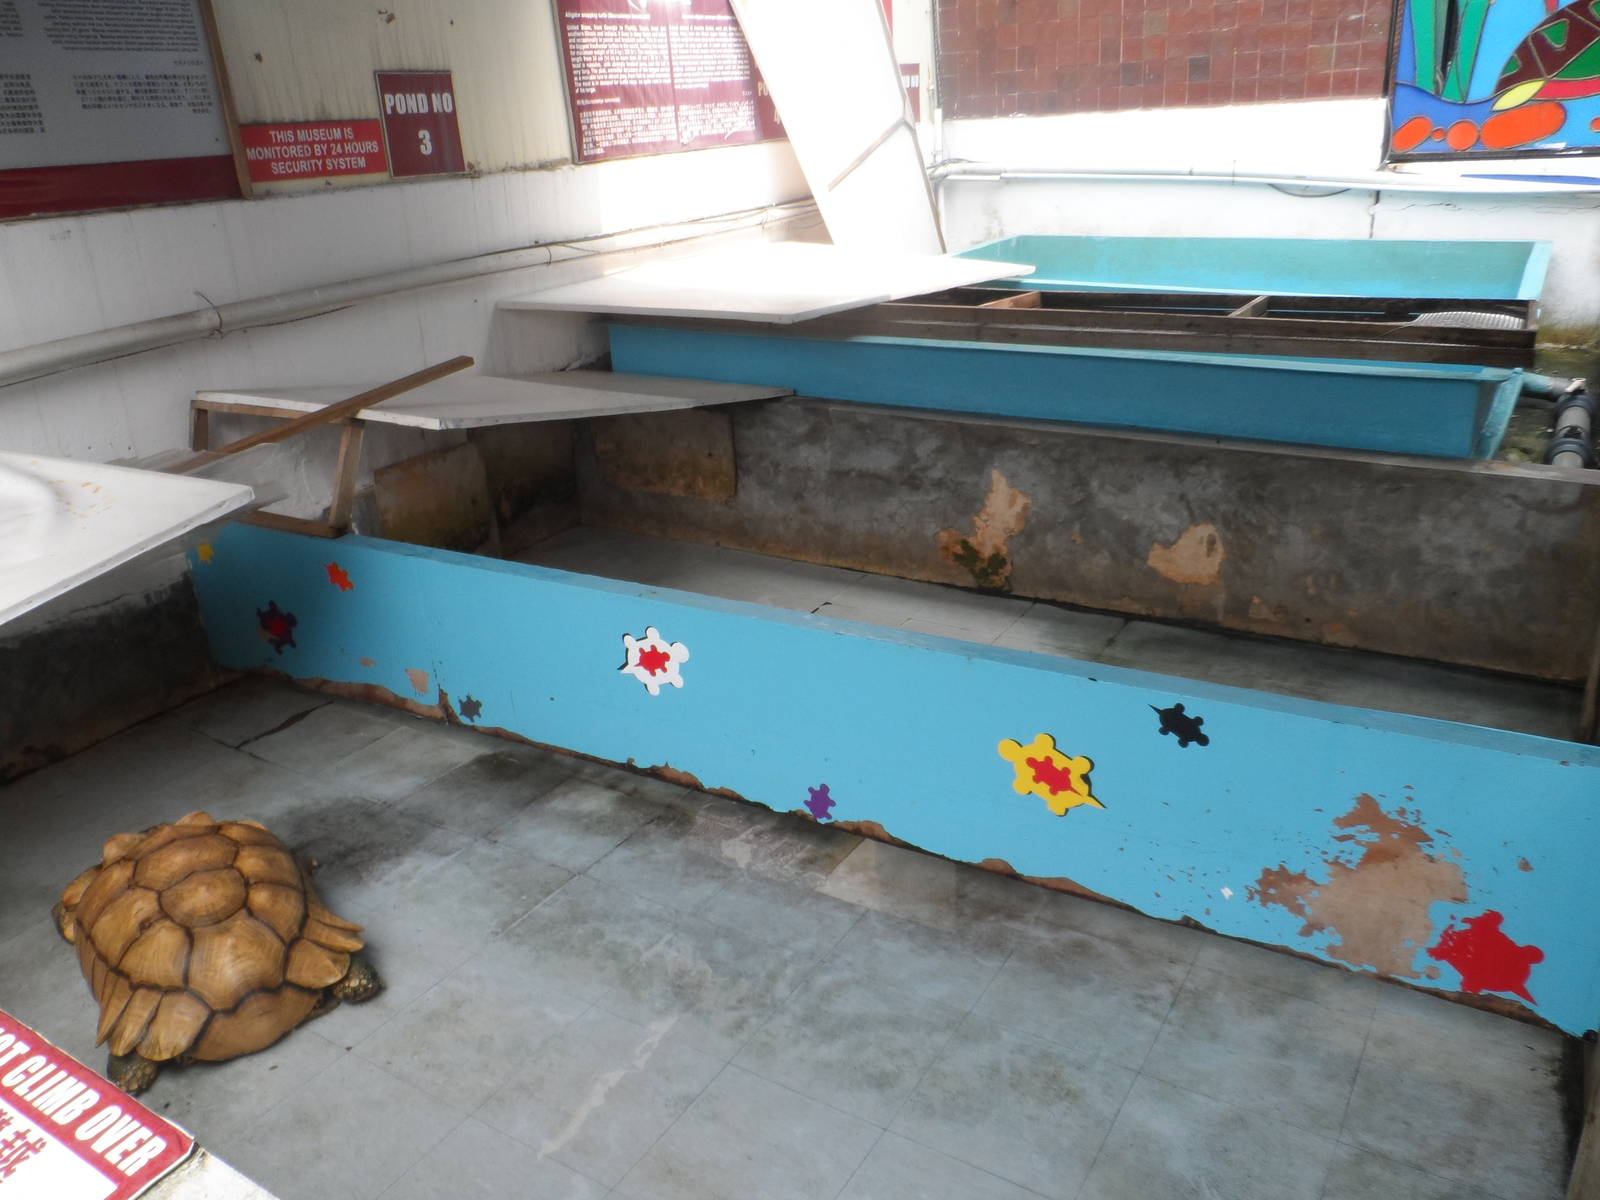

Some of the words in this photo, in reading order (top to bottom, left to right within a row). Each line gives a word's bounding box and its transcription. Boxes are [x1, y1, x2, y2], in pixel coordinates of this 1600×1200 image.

[384, 93, 429, 115] POND
[432, 92, 453, 113] NO
[269, 129, 294, 143] THIS
[297, 127, 342, 141] MUSEUM
[344, 126, 354, 140] IS
[419, 129, 432, 156] 3
[247, 145, 312, 161] MONITORED
[314, 144, 329, 157] BY
[331, 143, 343, 155] 24
[345, 141, 379, 154] HOURS
[271, 159, 324, 175] SECURITY
[326, 156, 366, 170] SYSTEM
[1, 1054, 100, 1126] CLIMB
[74, 1104, 168, 1177] OVER
